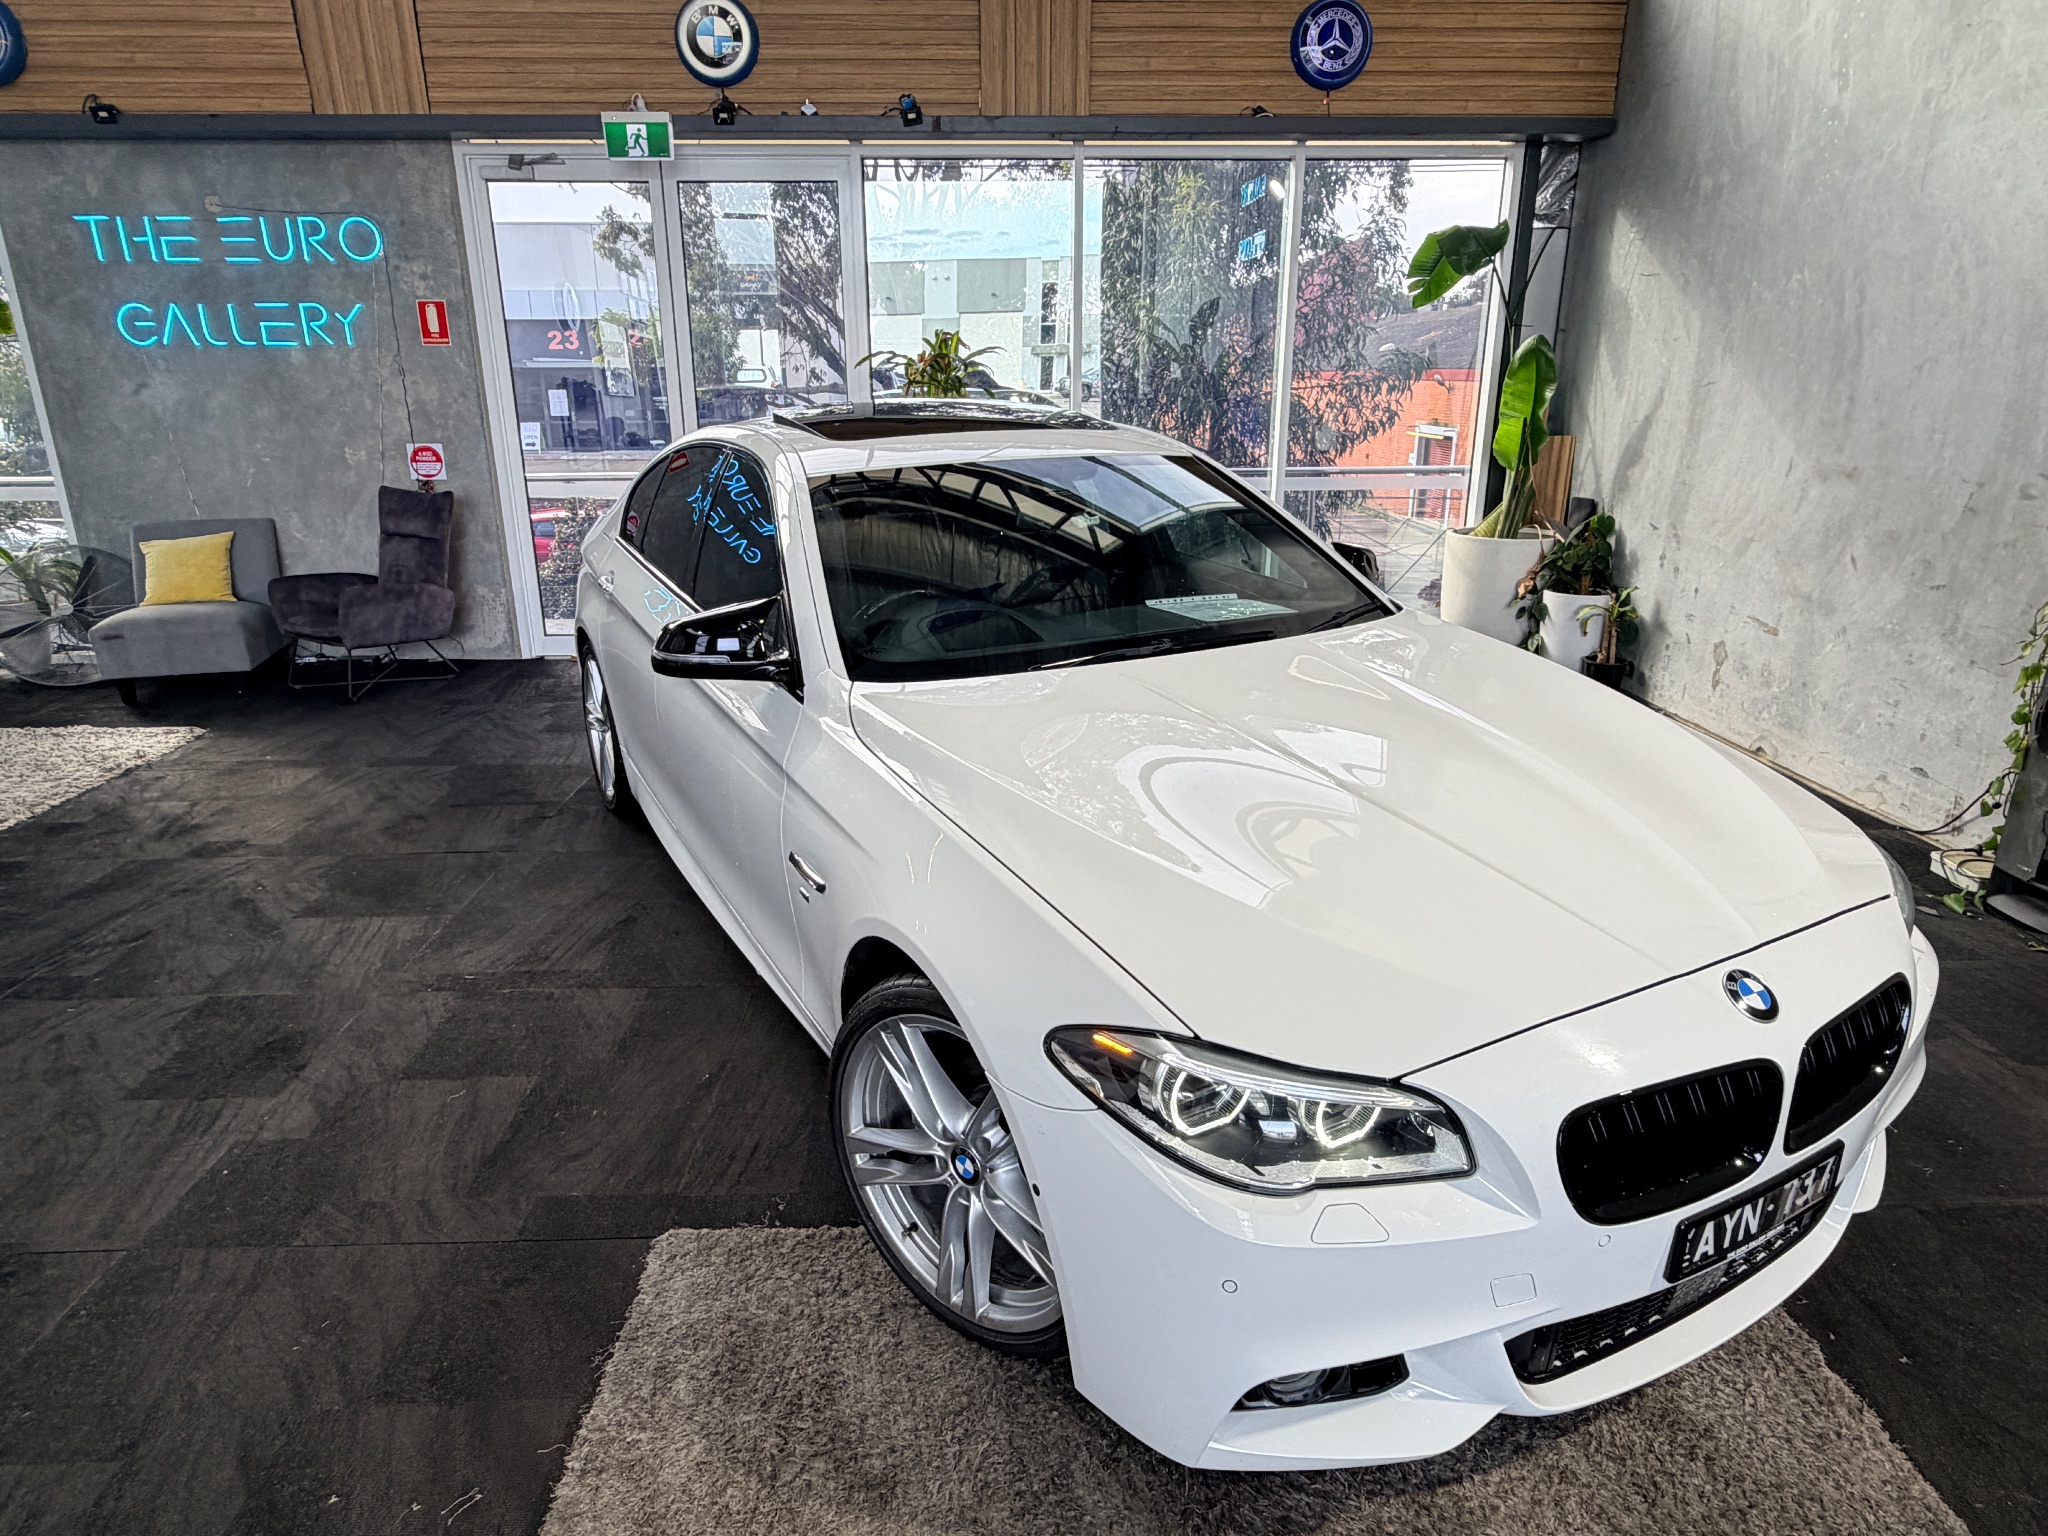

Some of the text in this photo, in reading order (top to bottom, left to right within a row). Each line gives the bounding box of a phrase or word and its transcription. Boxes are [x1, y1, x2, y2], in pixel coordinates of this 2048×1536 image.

[690, 5, 738, 26] BMW
[1317, 9, 1356, 27] MERCEDES
[1322, 60, 1344, 70] BENZ
[72, 214, 384, 264] THE EURO
[115, 301, 366, 348] GALLERY
[547, 330, 580, 350] 23
